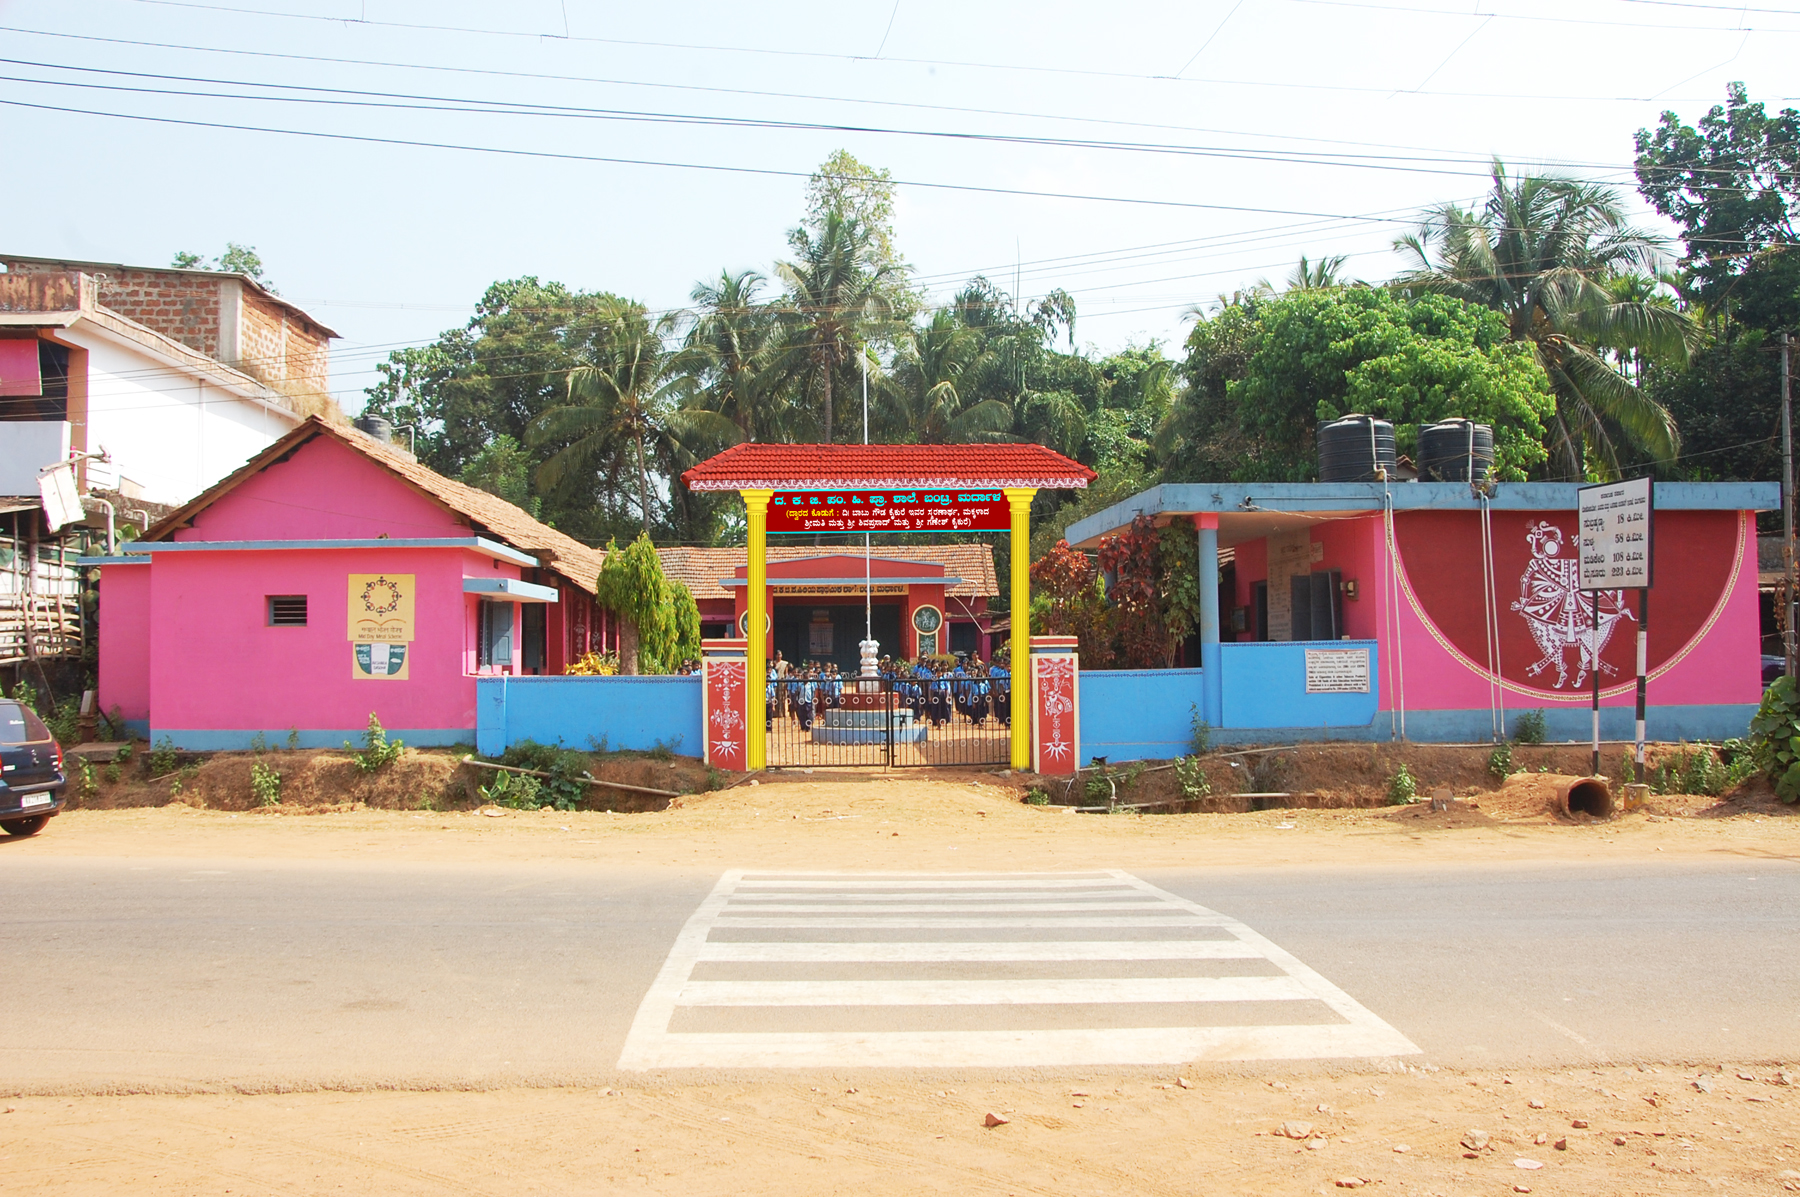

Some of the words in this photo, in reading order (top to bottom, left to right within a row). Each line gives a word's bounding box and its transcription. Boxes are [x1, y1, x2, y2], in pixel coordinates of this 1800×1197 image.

[774, 496, 787, 506] ದ.
[792, 495, 805, 506] ಕ.
[827, 494, 847, 505] ಪಂ.
[892, 492, 919, 504] ಶಾಲೆ,
[811, 508, 835, 517] ಕೊಡುಗೆ
[852, 509, 870, 517] ಬಾಬು
[872, 508, 886, 517] ಗೌಡ
[908, 508, 925, 517] ಇವರ
[962, 508, 990, 519] ಮಕ್ಕಳಾದ
[1617, 513, 1625, 525] 18
[804, 519, 826, 530] ಶ್ರೀಮತಿ
[828, 519, 845, 530] ಮತ್ತು
[847, 519, 856, 530] ಶ್ರೀ
[858, 518, 891, 530] ಶಿವಪ್ರಸಾದ್
[893, 518, 910, 529] ಮತ್ತು
[915, 518, 924, 529] ಶ್ರೀ
[1614, 533, 1624, 544] 58
[1613, 551, 1624, 563] 108
[1611, 566, 1624, 577] 223
